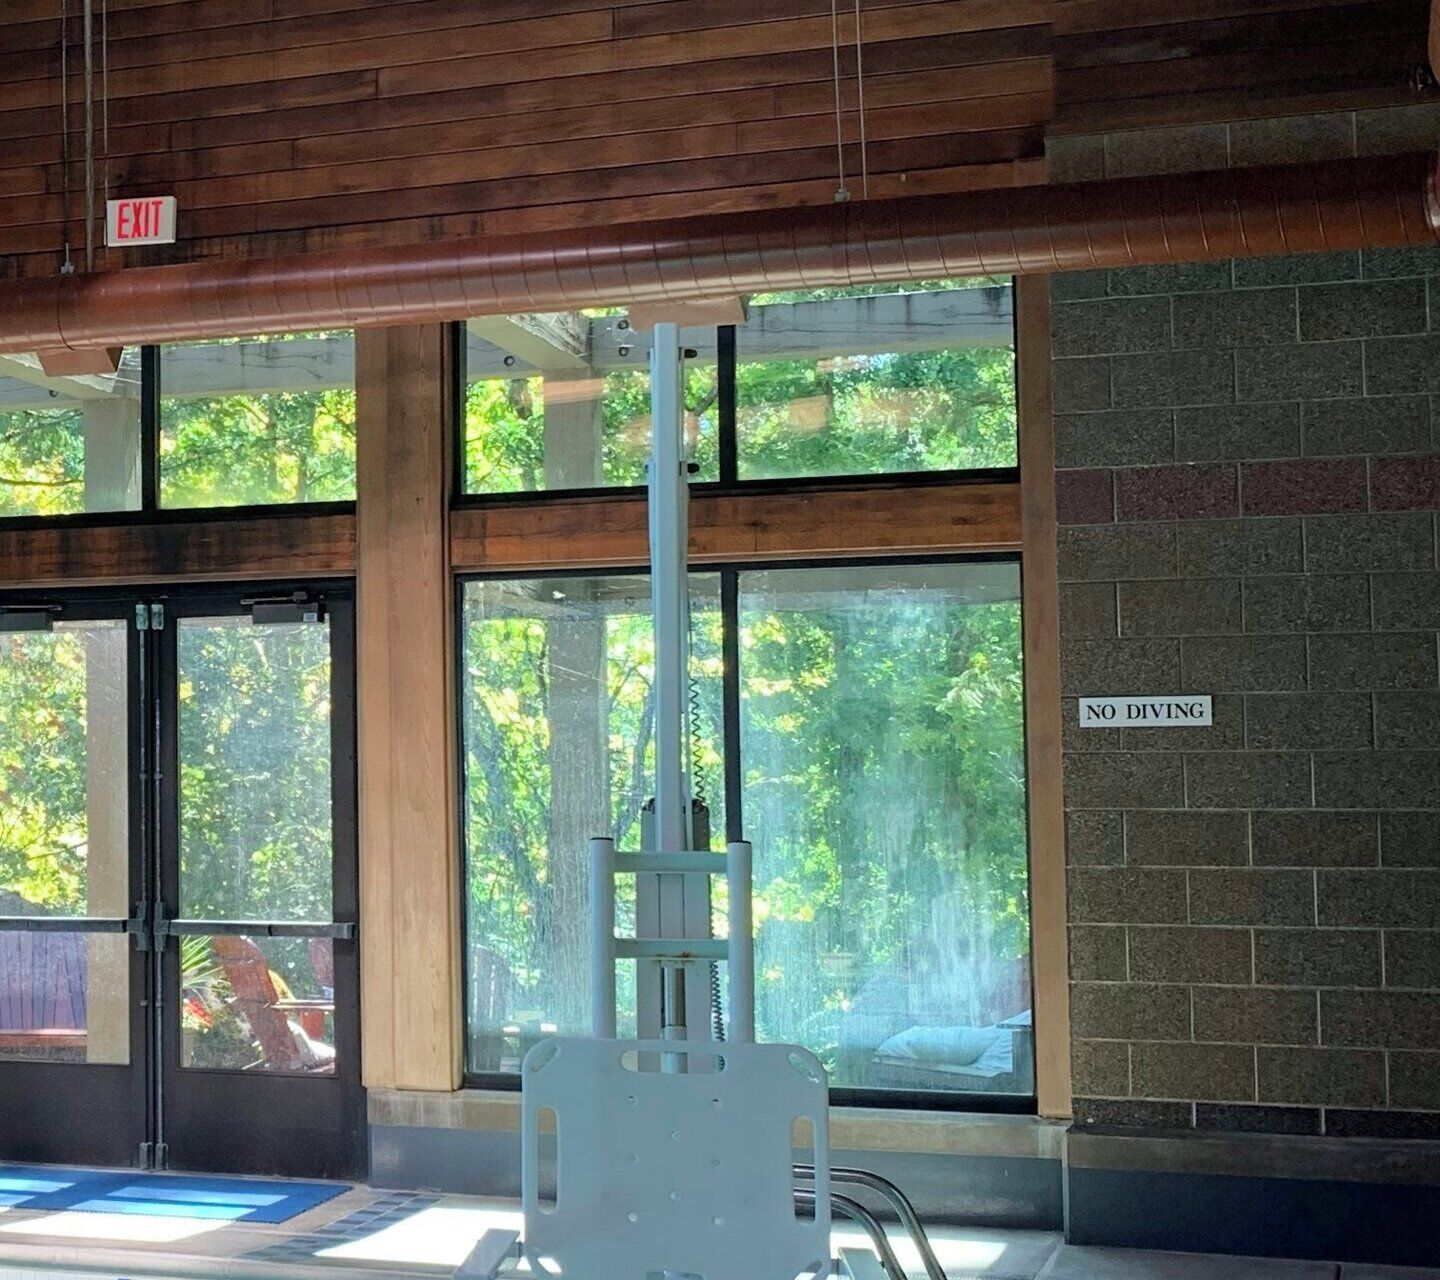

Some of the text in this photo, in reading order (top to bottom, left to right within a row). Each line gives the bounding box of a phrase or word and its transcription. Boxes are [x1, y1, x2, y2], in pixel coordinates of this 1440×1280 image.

[117, 200, 164, 240] EXIT
[1086, 702, 1204, 720] NO DIVING
